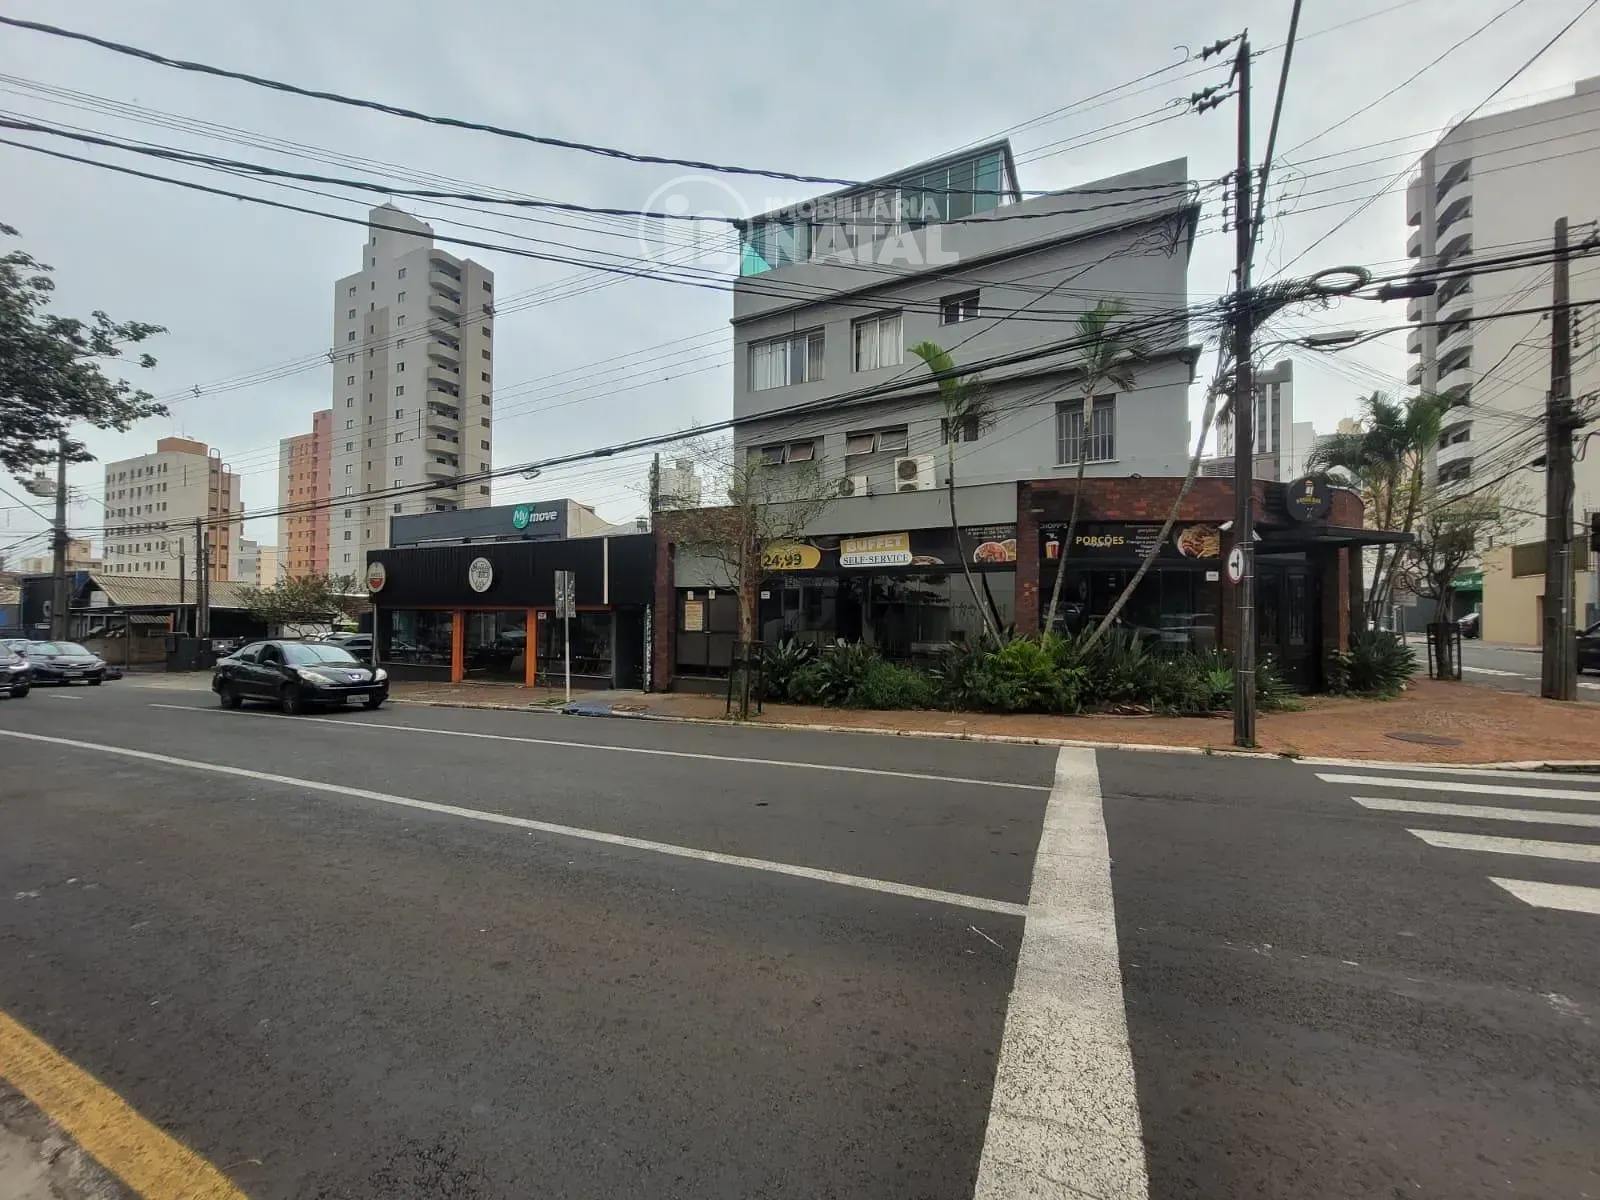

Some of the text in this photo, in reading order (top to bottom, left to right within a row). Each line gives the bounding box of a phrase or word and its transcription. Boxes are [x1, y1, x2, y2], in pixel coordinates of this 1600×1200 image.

[513, 510, 558, 524] My move
[846, 534, 903, 552] BUFFET
[1075, 534, 1124, 546] PORÇÕES
[843, 553, 910, 565] SELF-SERVICE
